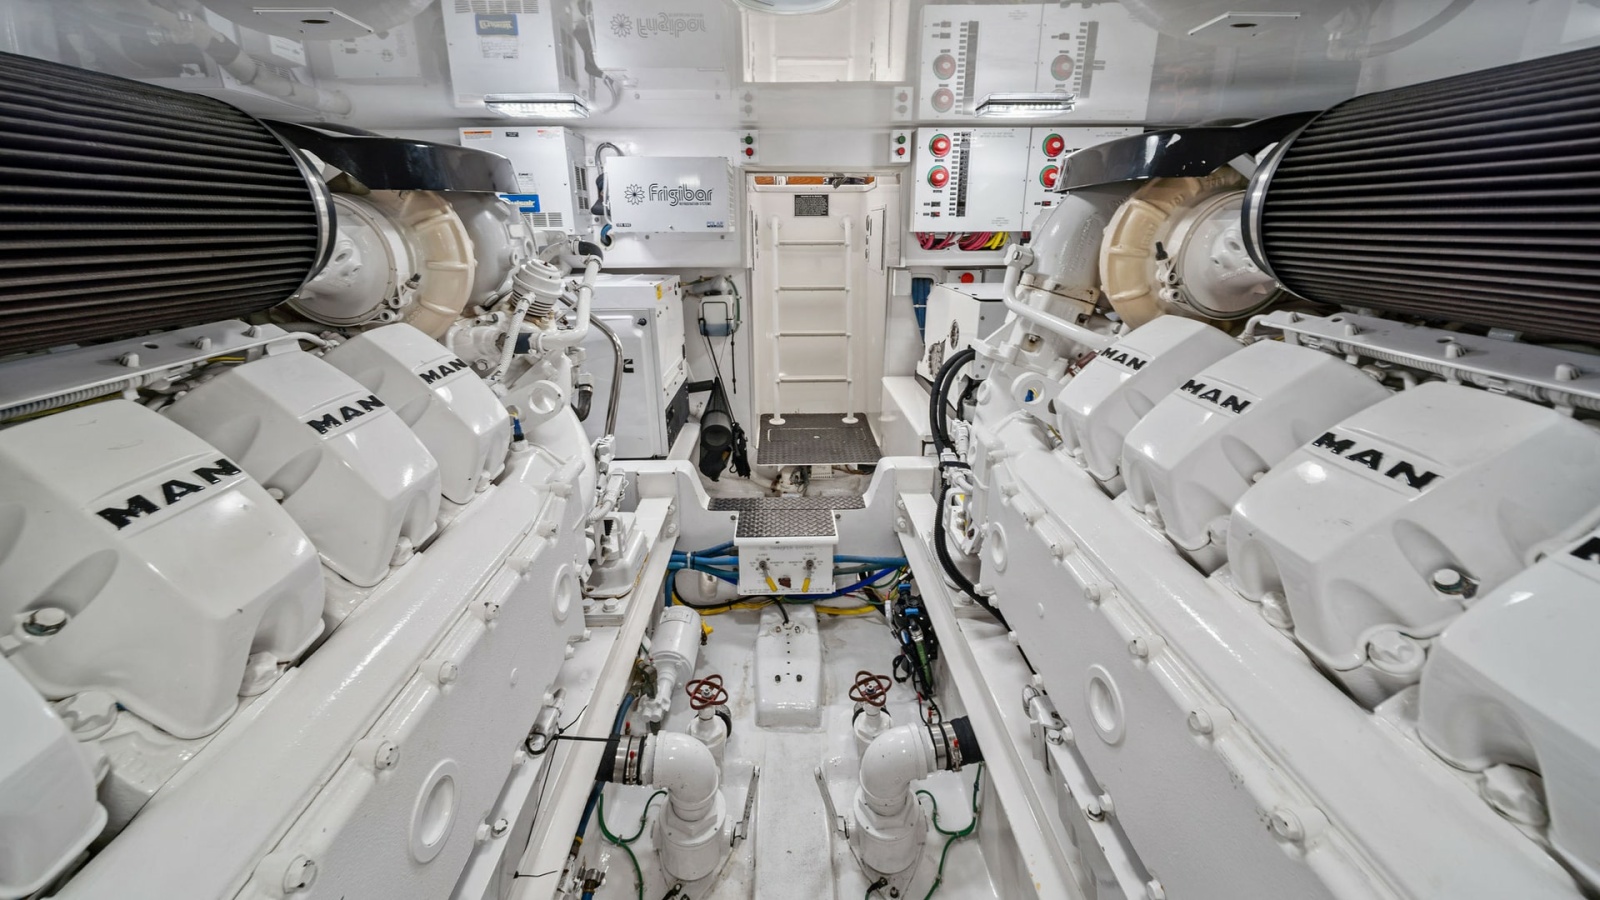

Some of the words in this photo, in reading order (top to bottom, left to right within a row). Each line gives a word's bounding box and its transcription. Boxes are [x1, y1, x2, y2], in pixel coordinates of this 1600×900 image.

[648, 183, 714, 207] Frigibar
[419, 358, 468, 384] MAN
[1101, 347, 1147, 371] MAN
[1181, 380, 1252, 413] MAN
[307, 395, 384, 434] MAN
[1312, 432, 1439, 490] MAN
[96, 459, 241, 530] MAN
